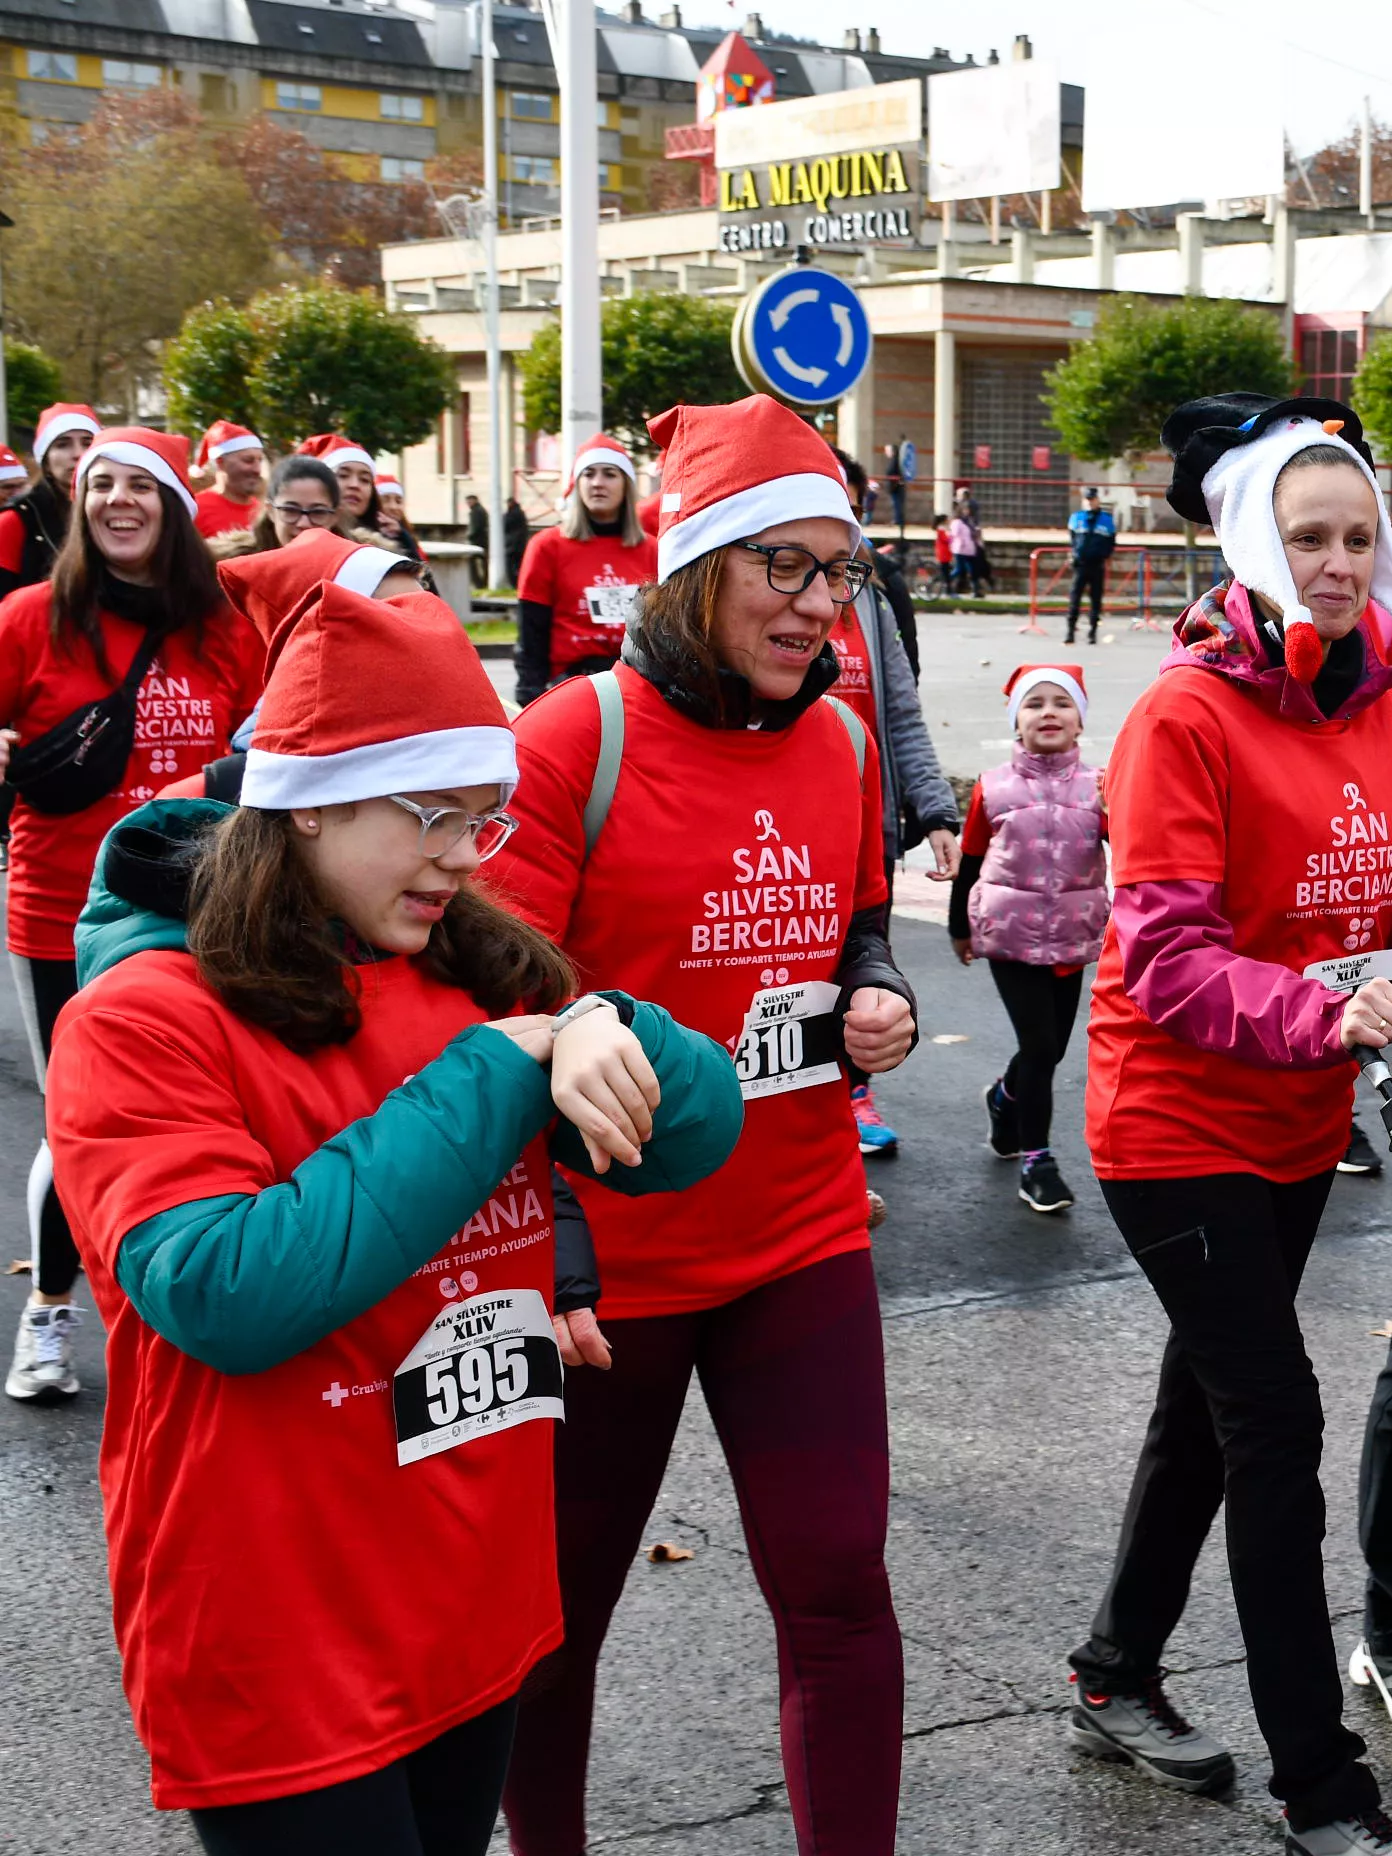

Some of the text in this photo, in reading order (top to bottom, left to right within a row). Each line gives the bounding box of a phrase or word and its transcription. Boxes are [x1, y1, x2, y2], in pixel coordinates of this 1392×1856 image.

[720, 151, 908, 213] LA MAQUINA
[720, 209, 911, 253] CENTRO COMERCIAL
[136, 699, 212, 718] VESTRE
[134, 718, 215, 739] RCIANA
[1330, 812, 1388, 847] SAN
[732, 845, 811, 884] SAN
[703, 883, 837, 919] SILVESTRE
[1319, 905, 1361, 915] COMPARTE
[691, 914, 839, 953] BERCIANA
[679, 958, 712, 969] ÚNETE
[715, 957, 725, 967] Y
[724, 955, 773, 966] COMPARTE
[775, 951, 805, 962] TIEMPO
[1321, 964, 1336, 972] SAN
[1336, 968, 1361, 983] XLIV
[760, 1001, 794, 1019] XLIV
[763, 990, 805, 1004] SILVESTRE
[735, 1020, 804, 1081] 310
[453, 1245, 498, 1267] TIEMPO
[501, 1227, 551, 1255] AYUDANDO
[434, 1299, 513, 1331] SAN SILVESTRE
[453, 1313, 496, 1342] XLIV
[352, 1384, 374, 1396] Cruz
[425, 1337, 529, 1426] 595
